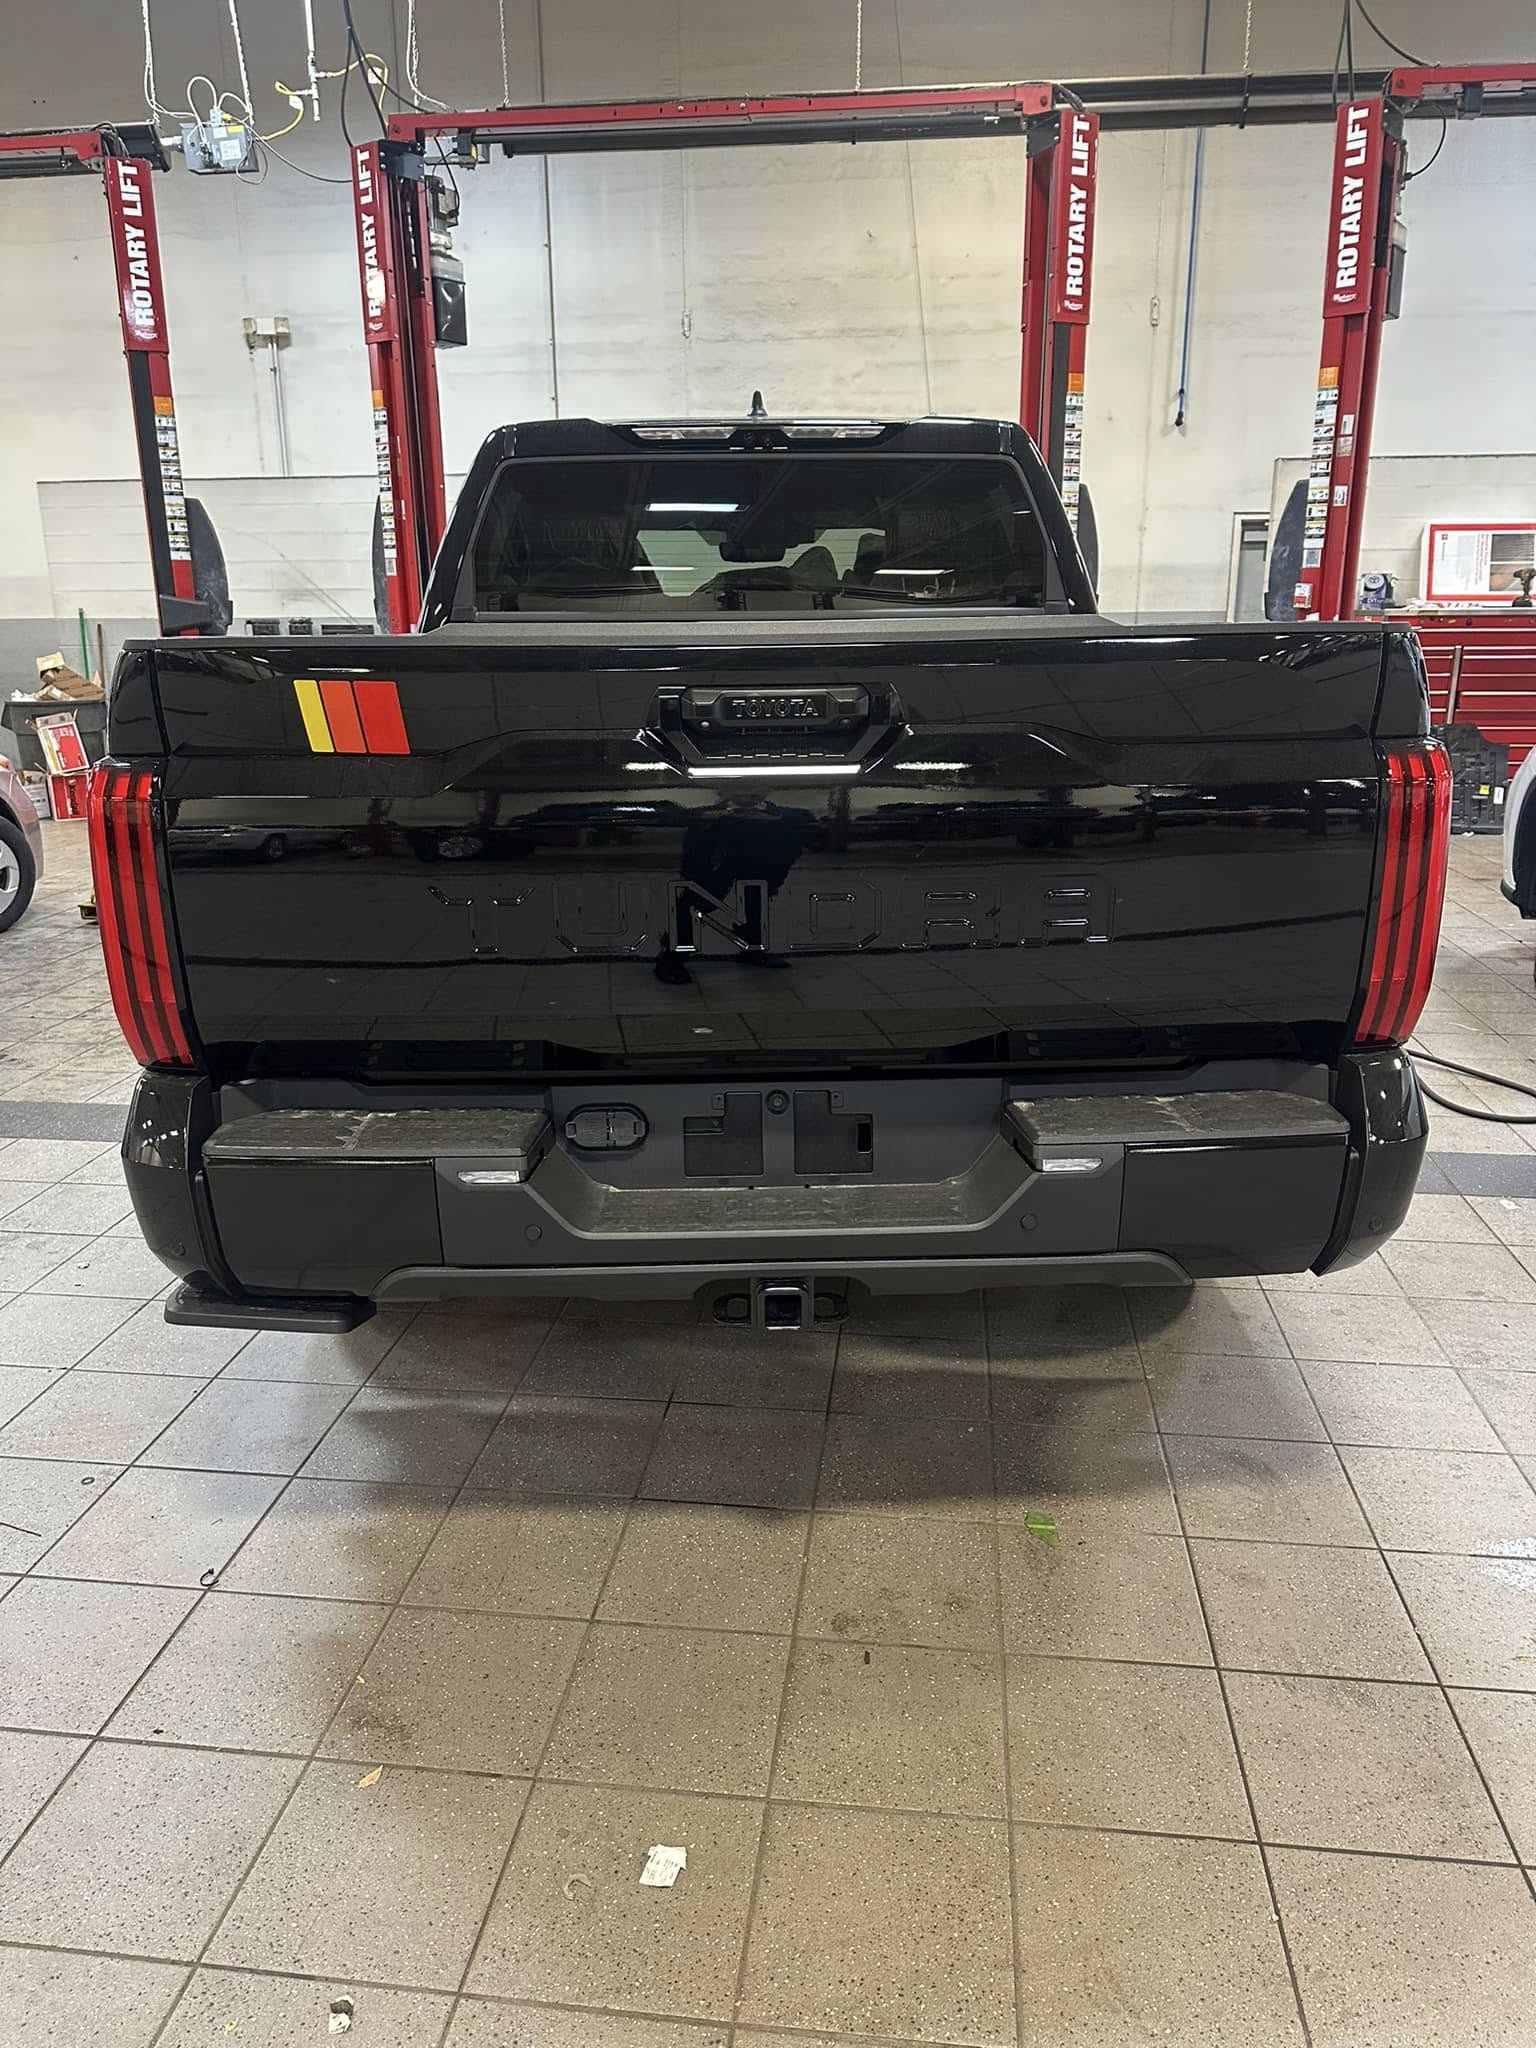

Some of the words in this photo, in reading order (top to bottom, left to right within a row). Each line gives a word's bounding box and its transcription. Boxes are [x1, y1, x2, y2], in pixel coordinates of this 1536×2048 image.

[1071, 115, 1090, 176] LIFT
[1344, 106, 1369, 167] LIFT
[117, 160, 143, 217] LIFT
[356, 148, 373, 205] LIFT
[1066, 184, 1087, 296] ROTARY
[1336, 175, 1364, 289] ROTARY
[125, 223, 155, 326] ROTARY
[732, 699, 819, 717] TOYOTA
[428, 876, 1116, 953] TUNDRA
